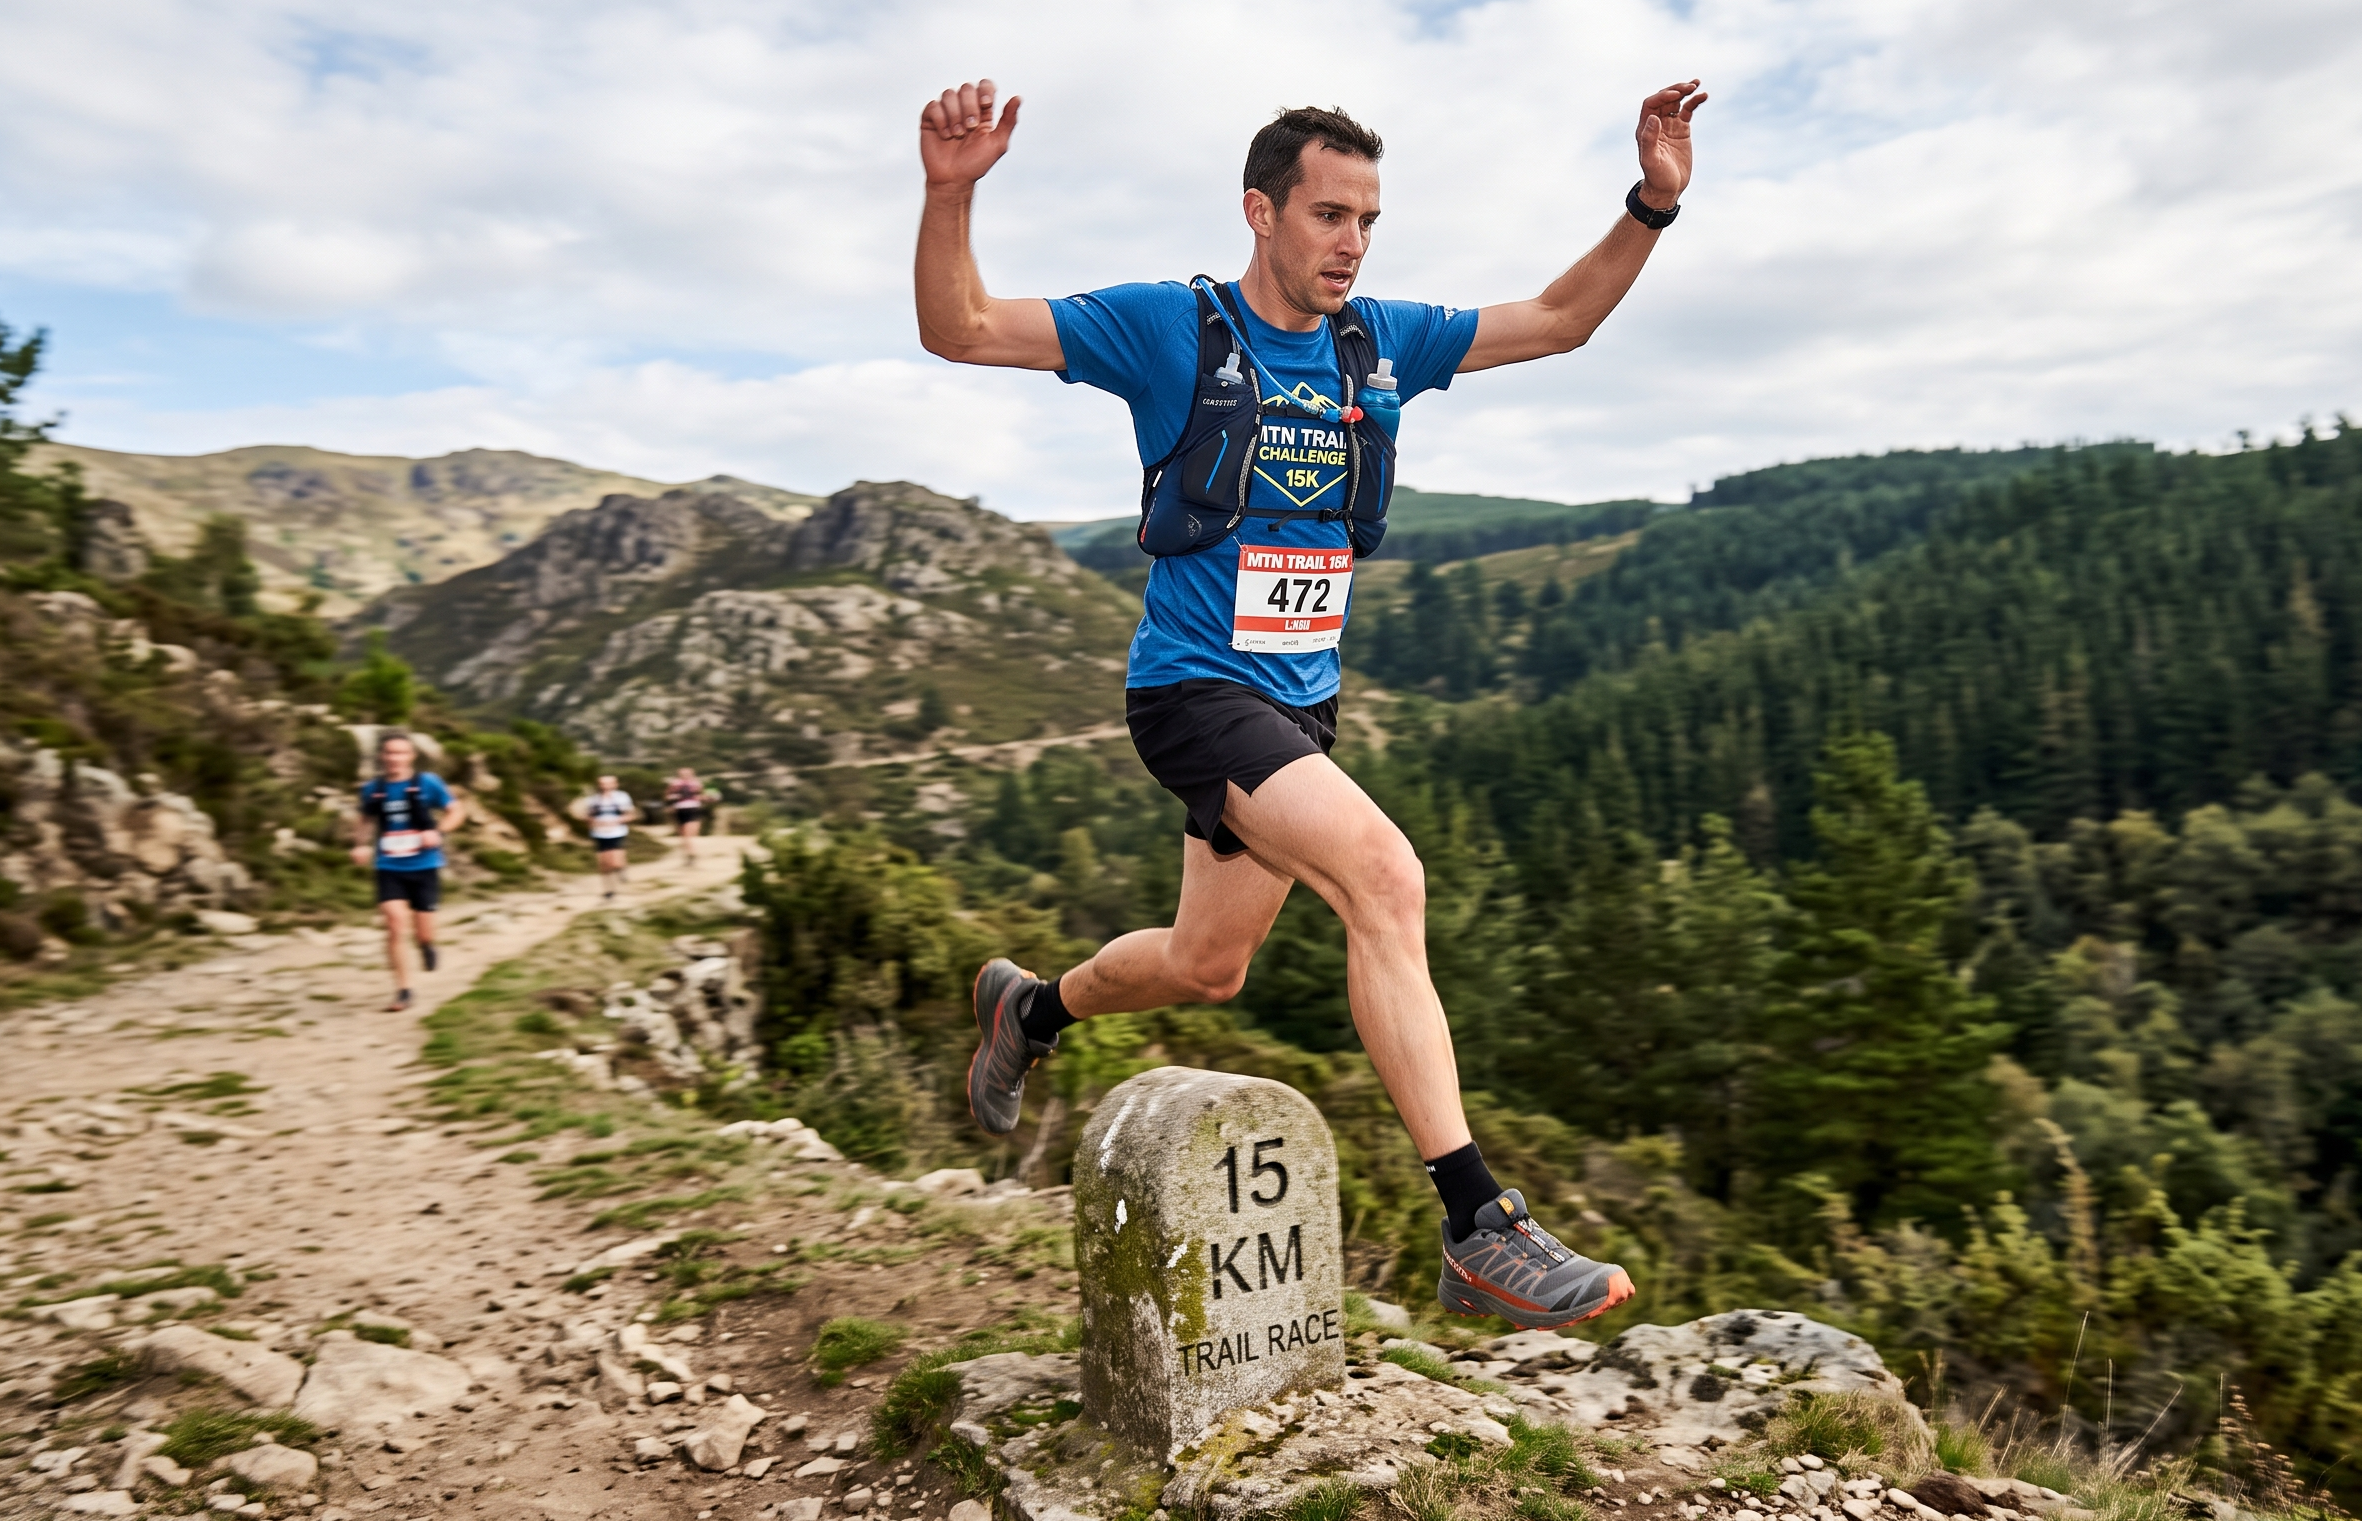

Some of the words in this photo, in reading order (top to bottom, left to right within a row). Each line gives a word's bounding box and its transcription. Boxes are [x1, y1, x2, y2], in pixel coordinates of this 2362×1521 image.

[1301, 428, 1347, 449] TRAI
[1259, 446, 1347, 466] CHALLENGE
[1286, 468, 1320, 488] 15K
[1247, 552, 1284, 569] MTN
[1286, 554, 1327, 570] TRAIL
[1267, 578, 1331, 613] 472
[1213, 1137, 1289, 1214] 15
[1210, 1224, 1304, 1300] KM
[1176, 1331, 1260, 1377] TRAIL
[1268, 1309, 1340, 1356] RACE
